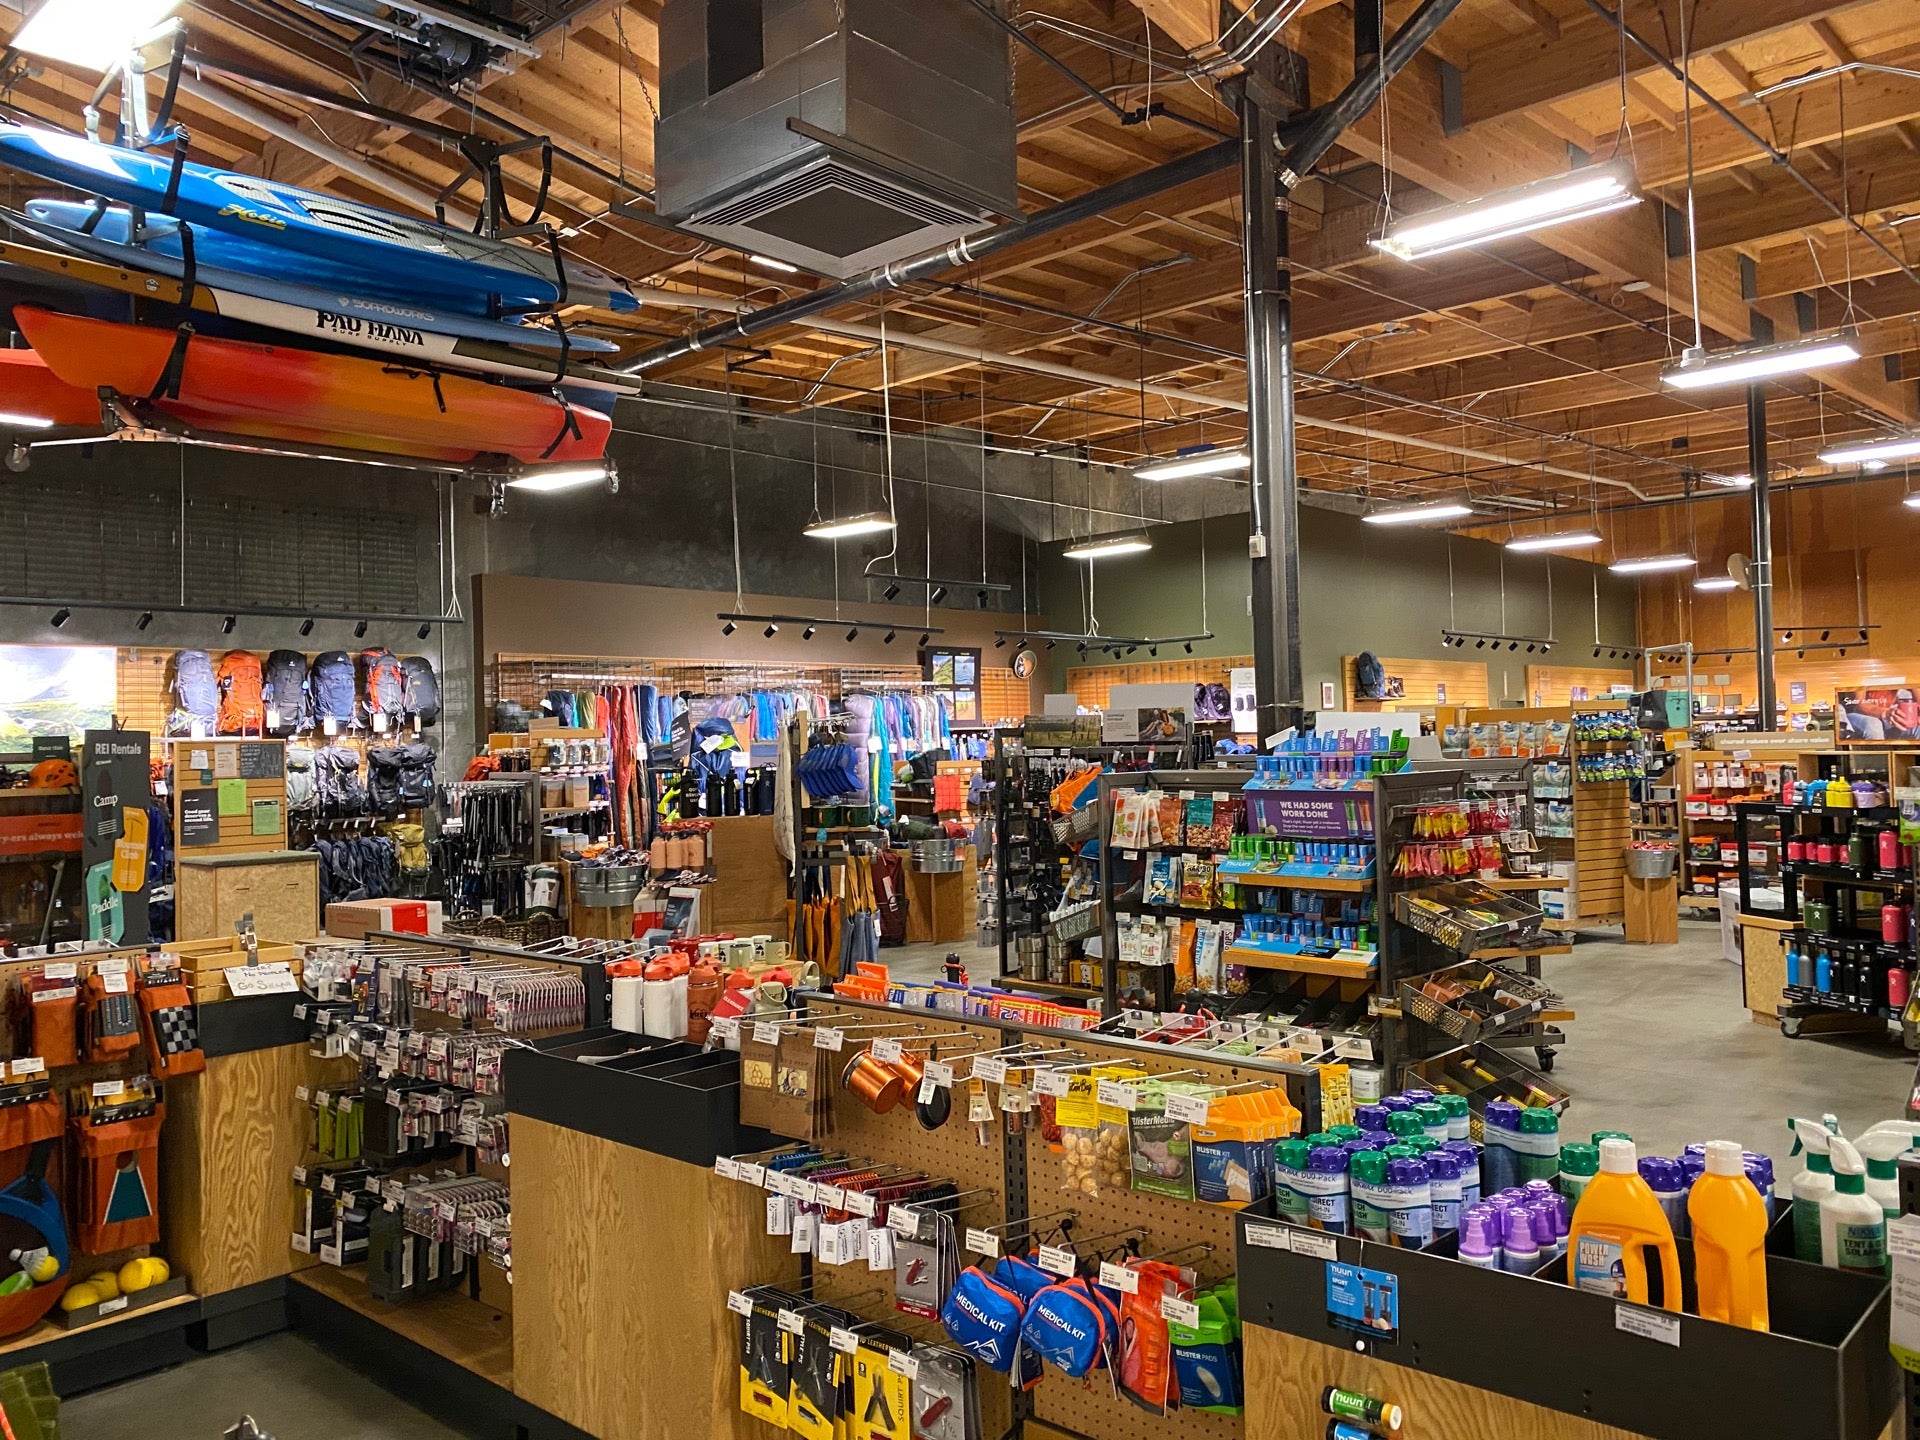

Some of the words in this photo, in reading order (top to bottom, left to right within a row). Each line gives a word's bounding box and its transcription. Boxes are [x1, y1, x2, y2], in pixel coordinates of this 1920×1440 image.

[218, 203, 287, 230] Hobie
[353, 299, 435, 322] BOARDWORKS
[317, 310, 361, 332] PAU
[368, 322, 424, 346] HANA
[332, 328, 360, 337] SURF
[367, 335, 407, 346] SUPPLY
[95, 743, 110, 755] REI
[111, 742, 141, 755] Rentals
[93, 795, 118, 808] Camp
[1279, 801, 1293, 809] WE
[1293, 801, 1310, 809] HAD
[1310, 802, 1334, 810] SOME
[1281, 810, 1305, 818] WORK
[1306, 810, 1329, 819] DONE
[91, 897, 119, 915] Paddle
[723, 995, 744, 1012] CLEARANCE
[1196, 1145, 1222, 1157] BLISTER
[1222, 1149, 1231, 1157] KIT
[1579, 1241, 1609, 1255] POWER
[1843, 1239, 1866, 1248] TENT
[1580, 1253, 1605, 1266] WASH
[1330, 1264, 1353, 1277] nuun
[1332, 1277, 1348, 1286] SPORT
[752, 1304, 778, 1319] LEATHERMA
[955, 1292, 988, 1325] MEDICAL
[989, 1319, 1006, 1333] KIT
[808, 1320, 830, 1338] LEATHERM
[1037, 1304, 1072, 1334] MEDICAL
[1071, 1328, 1086, 1341] KIT
[1175, 1349, 1201, 1360] BLISTER
[1201, 1351, 1218, 1363] PADS
[860, 1363, 864, 1371] 9
[1335, 1392, 1365, 1407] nuun
